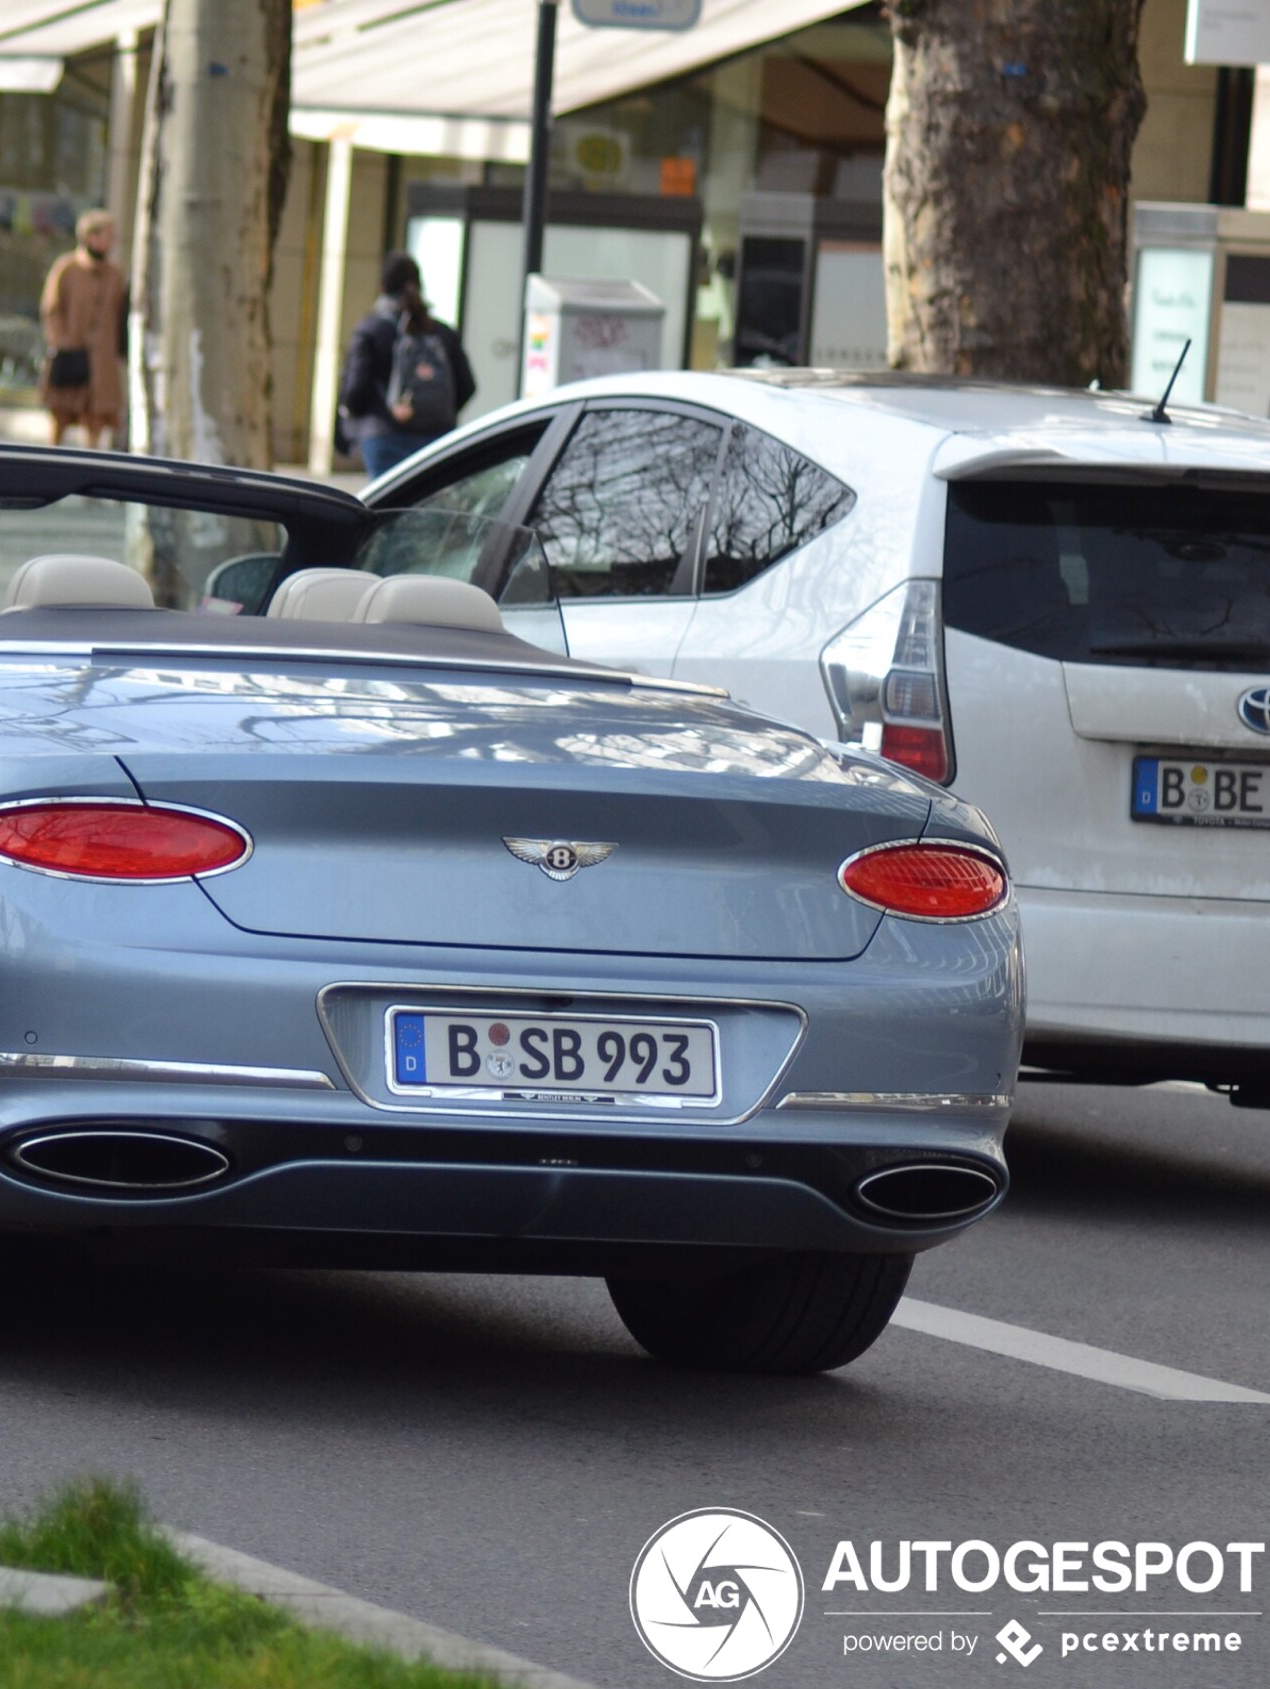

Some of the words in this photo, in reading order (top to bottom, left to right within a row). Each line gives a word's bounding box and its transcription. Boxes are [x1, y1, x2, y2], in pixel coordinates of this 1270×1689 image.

[1162, 767, 1185, 808] B
[1214, 770, 1263, 812] BE
[1142, 793, 1150, 805] D
[1194, 817, 1225, 826] TOYOTA
[448, 1024, 481, 1077] B
[519, 1028, 585, 1081] SB
[596, 1031, 691, 1086] 993
[406, 1056, 417, 1071] D
